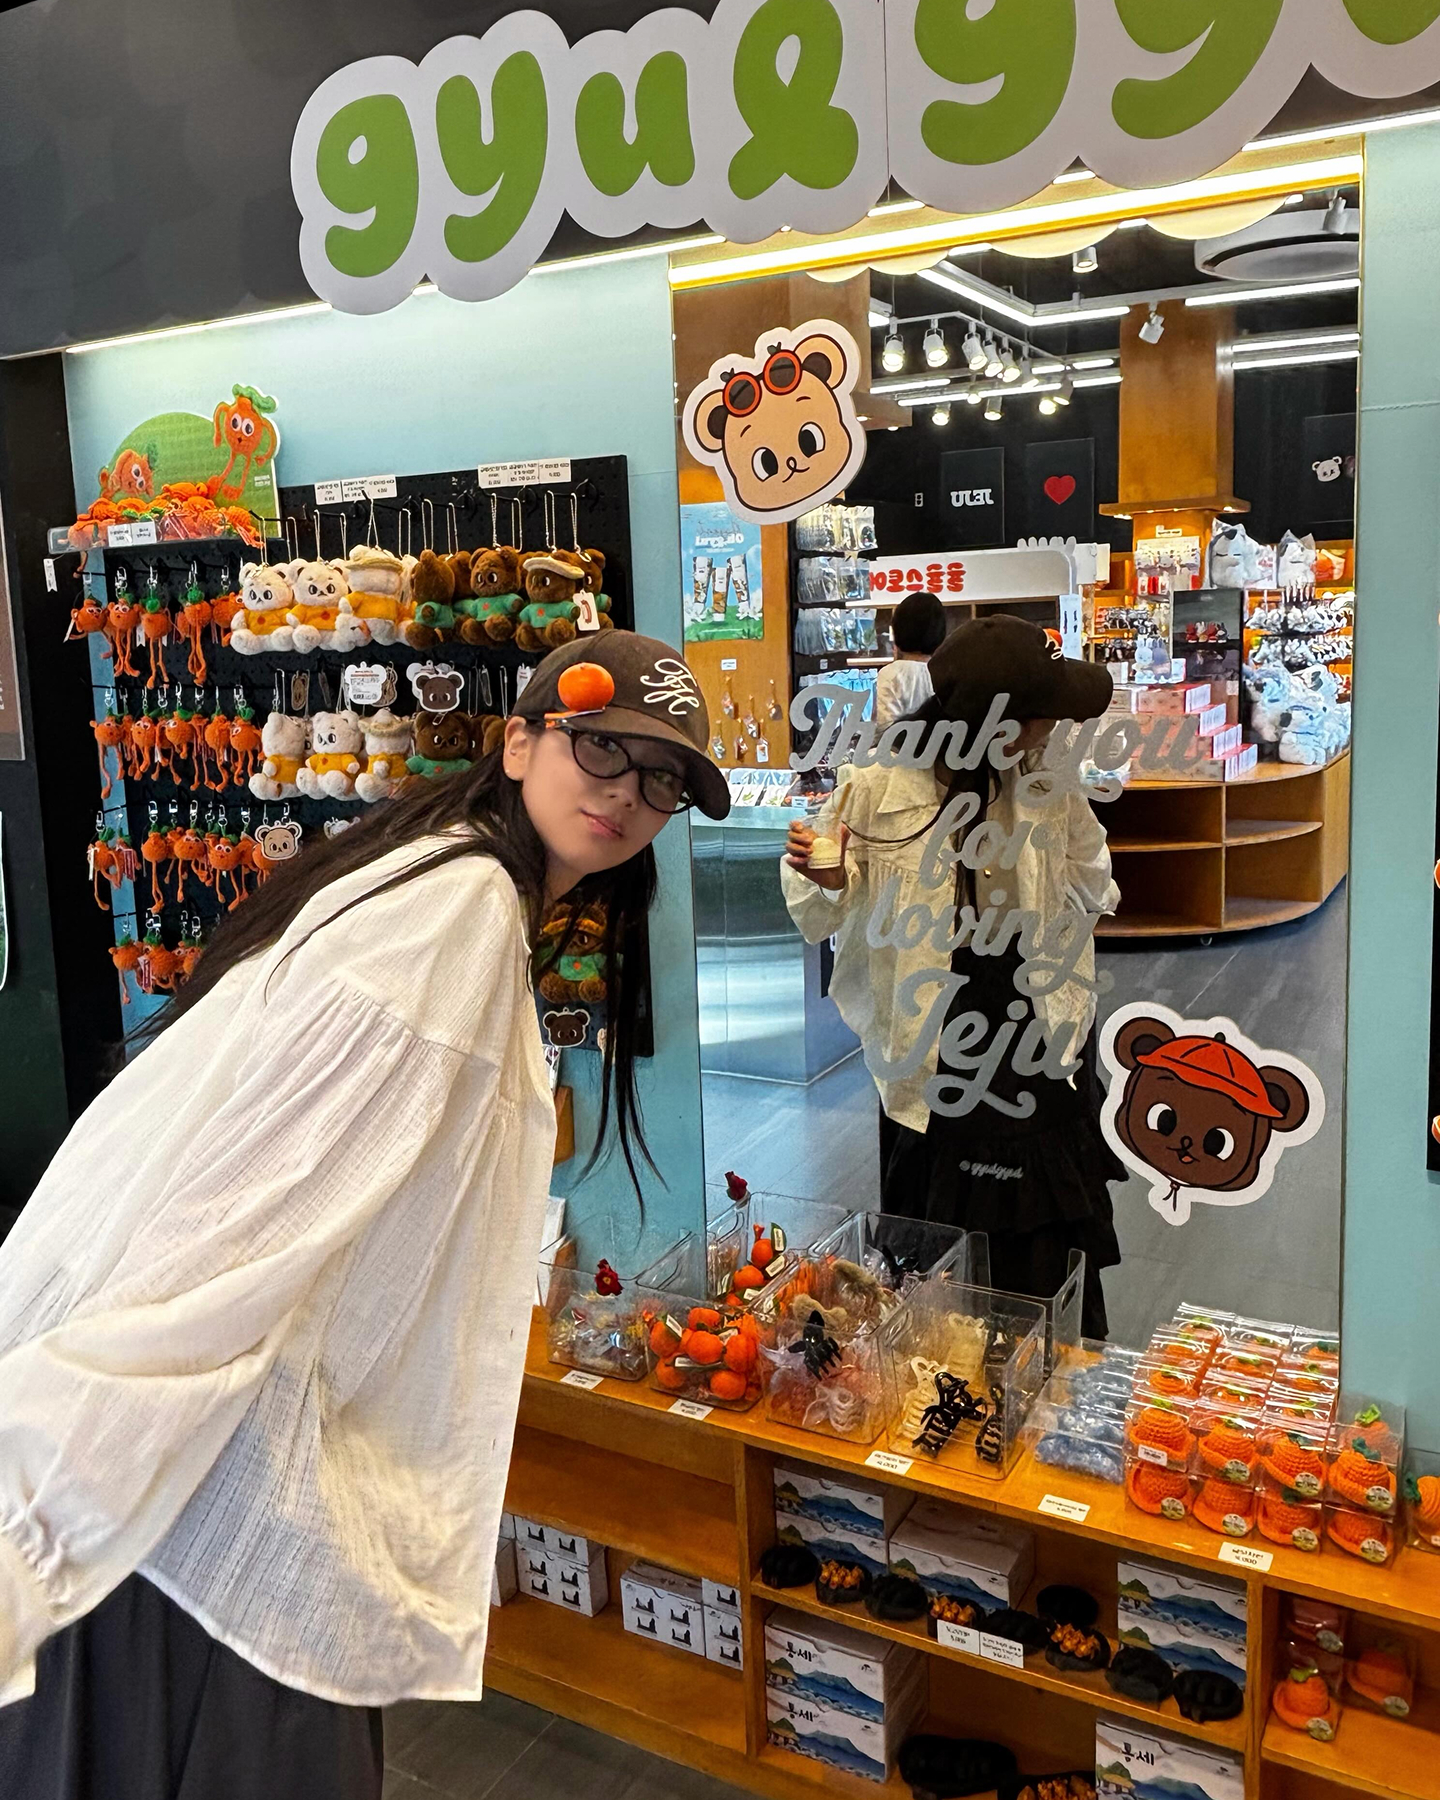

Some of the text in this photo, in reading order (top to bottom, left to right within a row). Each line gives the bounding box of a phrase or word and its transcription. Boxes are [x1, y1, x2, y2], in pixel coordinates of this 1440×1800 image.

[789, 683, 1025, 773] Thank
[1015, 717, 1203, 805] you
[919, 792, 1054, 889] for
[866, 876, 1115, 997] loving
[864, 967, 1083, 1119] Jeju
